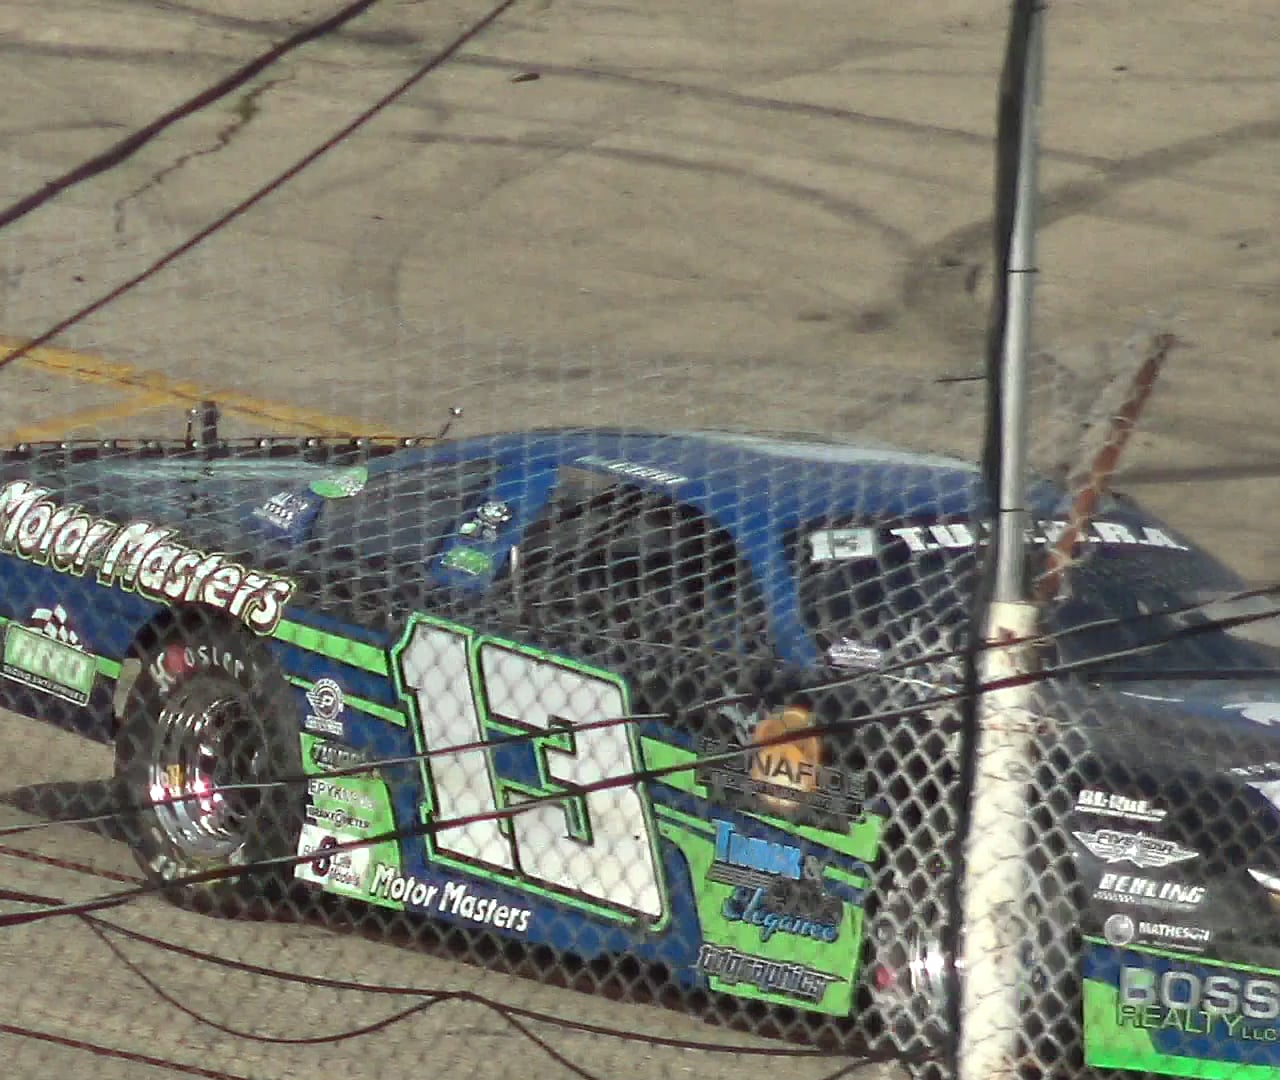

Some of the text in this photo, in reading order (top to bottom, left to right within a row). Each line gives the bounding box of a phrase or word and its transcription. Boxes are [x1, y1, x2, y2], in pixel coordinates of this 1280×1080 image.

[96, 520, 296, 636] Masters
[389, 611, 672, 933] 13
[370, 863, 532, 932] Motor Masters
[1116, 1005, 1277, 1043] REALTY LLC
